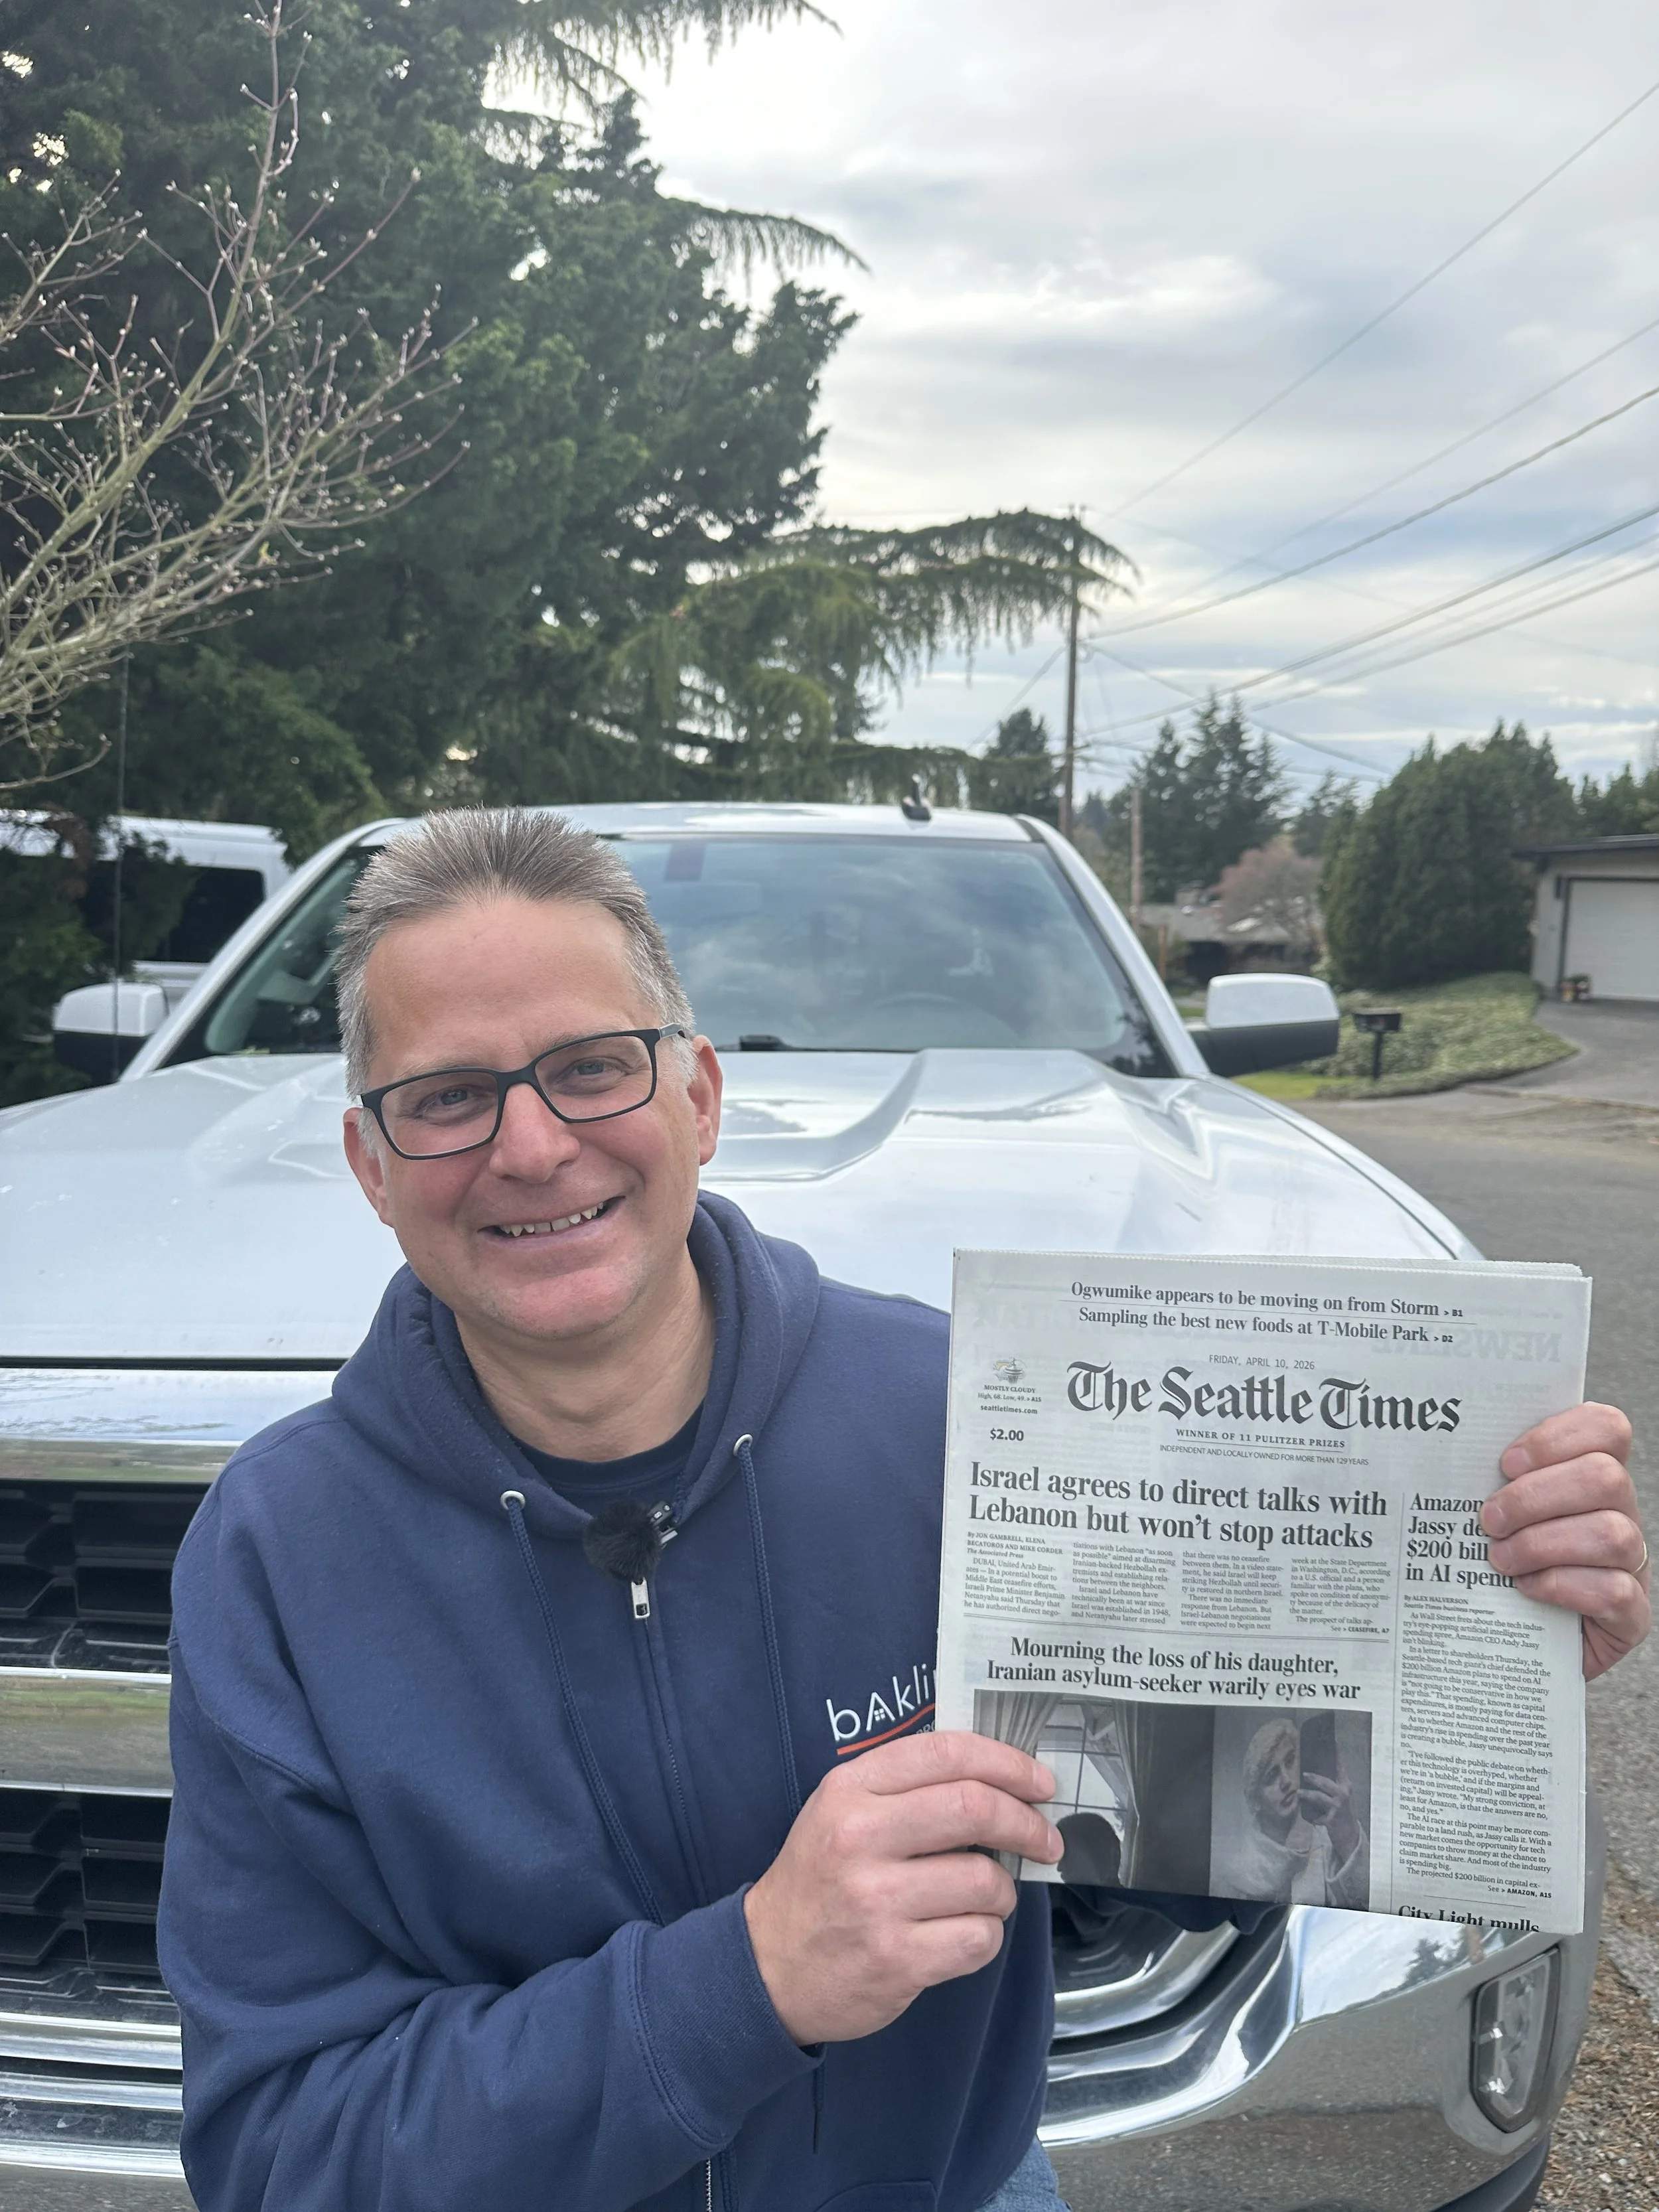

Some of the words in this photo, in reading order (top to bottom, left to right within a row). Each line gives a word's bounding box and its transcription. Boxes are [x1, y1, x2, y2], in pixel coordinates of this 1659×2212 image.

[1072, 1282, 1151, 1299] Ogwumike
[1156, 1290, 1214, 1305] appears
[1218, 1291, 1232, 1304] to
[1238, 1290, 1256, 1305] be
[1261, 1293, 1318, 1312] moving
[1323, 1299, 1342, 1310] on
[1348, 1296, 1386, 1313] from
[1391, 1299, 1439, 1315] Storm
[1080, 1307, 1148, 1328] Sampling
[1153, 1311, 1176, 1326] the
[1181, 1313, 1210, 1328] best
[1216, 1319, 1248, 1330] new
[1253, 1317, 1293, 1333] foods
[1298, 1322, 1313, 1334] at
[1318, 1321, 1388, 1339] T-Mobile
[1392, 1325, 1429, 1341] Park
[1209, 1355, 1241, 1366] FRIDAY,
[1246, 1357, 1270, 1367] APRIL
[1275, 1359, 1289, 1369] 10,
[1294, 1360, 1315, 1370] 2026
[1066, 1361, 1153, 1420] The
[1158, 1366, 1313, 1424] Seattle
[1319, 1378, 1463, 1432] Times
[981, 1406, 1038, 1414] seattletimes.com
[990, 1428, 1024, 1441] $2.00
[1176, 1429, 1218, 1439] WINNER
[1256, 1435, 1306, 1445] PULITZER
[1309, 1439, 1345, 1448] PRIZES
[1160, 1445, 1206, 1454] INDEPENDENT
[1224, 1449, 1253, 1458] LOCALLY
[971, 1461, 1039, 1491] Israel
[1048, 1475, 1131, 1501] agrees
[1139, 1479, 1163, 1502] to
[1173, 1479, 1249, 1509] direct
[1257, 1487, 1319, 1512] talks
[1329, 1491, 1387, 1515] with
[969, 1495, 1078, 1528] Lebanon
[1087, 1505, 1129, 1533] but
[1220, 1520, 1273, 1551] stop
[1281, 1523, 1372, 1548] attacks
[1408, 1516, 1457, 1540] Jassy
[968, 1540, 1003, 1548] BECATOROS
[1407, 1538, 1452, 1559] $200
[1459, 1541, 1488, 1561] bill
[998, 1560, 1019, 1569] United
[1406, 1563, 1424, 1581] in
[1429, 1564, 1451, 1582] AI
[966, 1574, 988, 1583] Middle
[965, 1591, 999, 1601] Netanyahu
[1015, 1597, 1046, 1607] Thursday
[986, 1585, 1005, 1593] Prime
[1006, 1587, 1033, 1596] Minister
[1034, 1590, 1065, 1599] Benjamin
[1079, 1585, 1098, 1594] Israel
[1113, 1588, 1141, 1597] Lebanon
[1143, 1589, 1159, 1598] have
[986, 1603, 1021, 1613] authorized
[1011, 1637, 1106, 1665] Mourning
[1112, 1645, 1143, 1665] the
[1149, 1648, 1184, 1668] loss
[1190, 1651, 1211, 1669] of
[1214, 1651, 1242, 1670] his
[1248, 1653, 1338, 1677] daughter,
[987, 1660, 1056, 1681] Iranian
[1062, 1666, 1202, 1693] asylum-seeker
[1208, 1677, 1269, 1700] warily
[1276, 1683, 1316, 1701] eyes
[1322, 1684, 1360, 1699] war
[826, 1663, 936, 1741] bAkli
[1415, 1834, 1440, 1842] market
[1477, 1842, 1518, 1850] opportunity
[1400, 1848, 1418, 1857] claim
[1522, 1863, 1551, 1874] industry
[1421, 1870, 1453, 1879] projected
[1473, 1874, 1496, 1883] billion
[1507, 1889, 1537, 1897] AMAZON,
